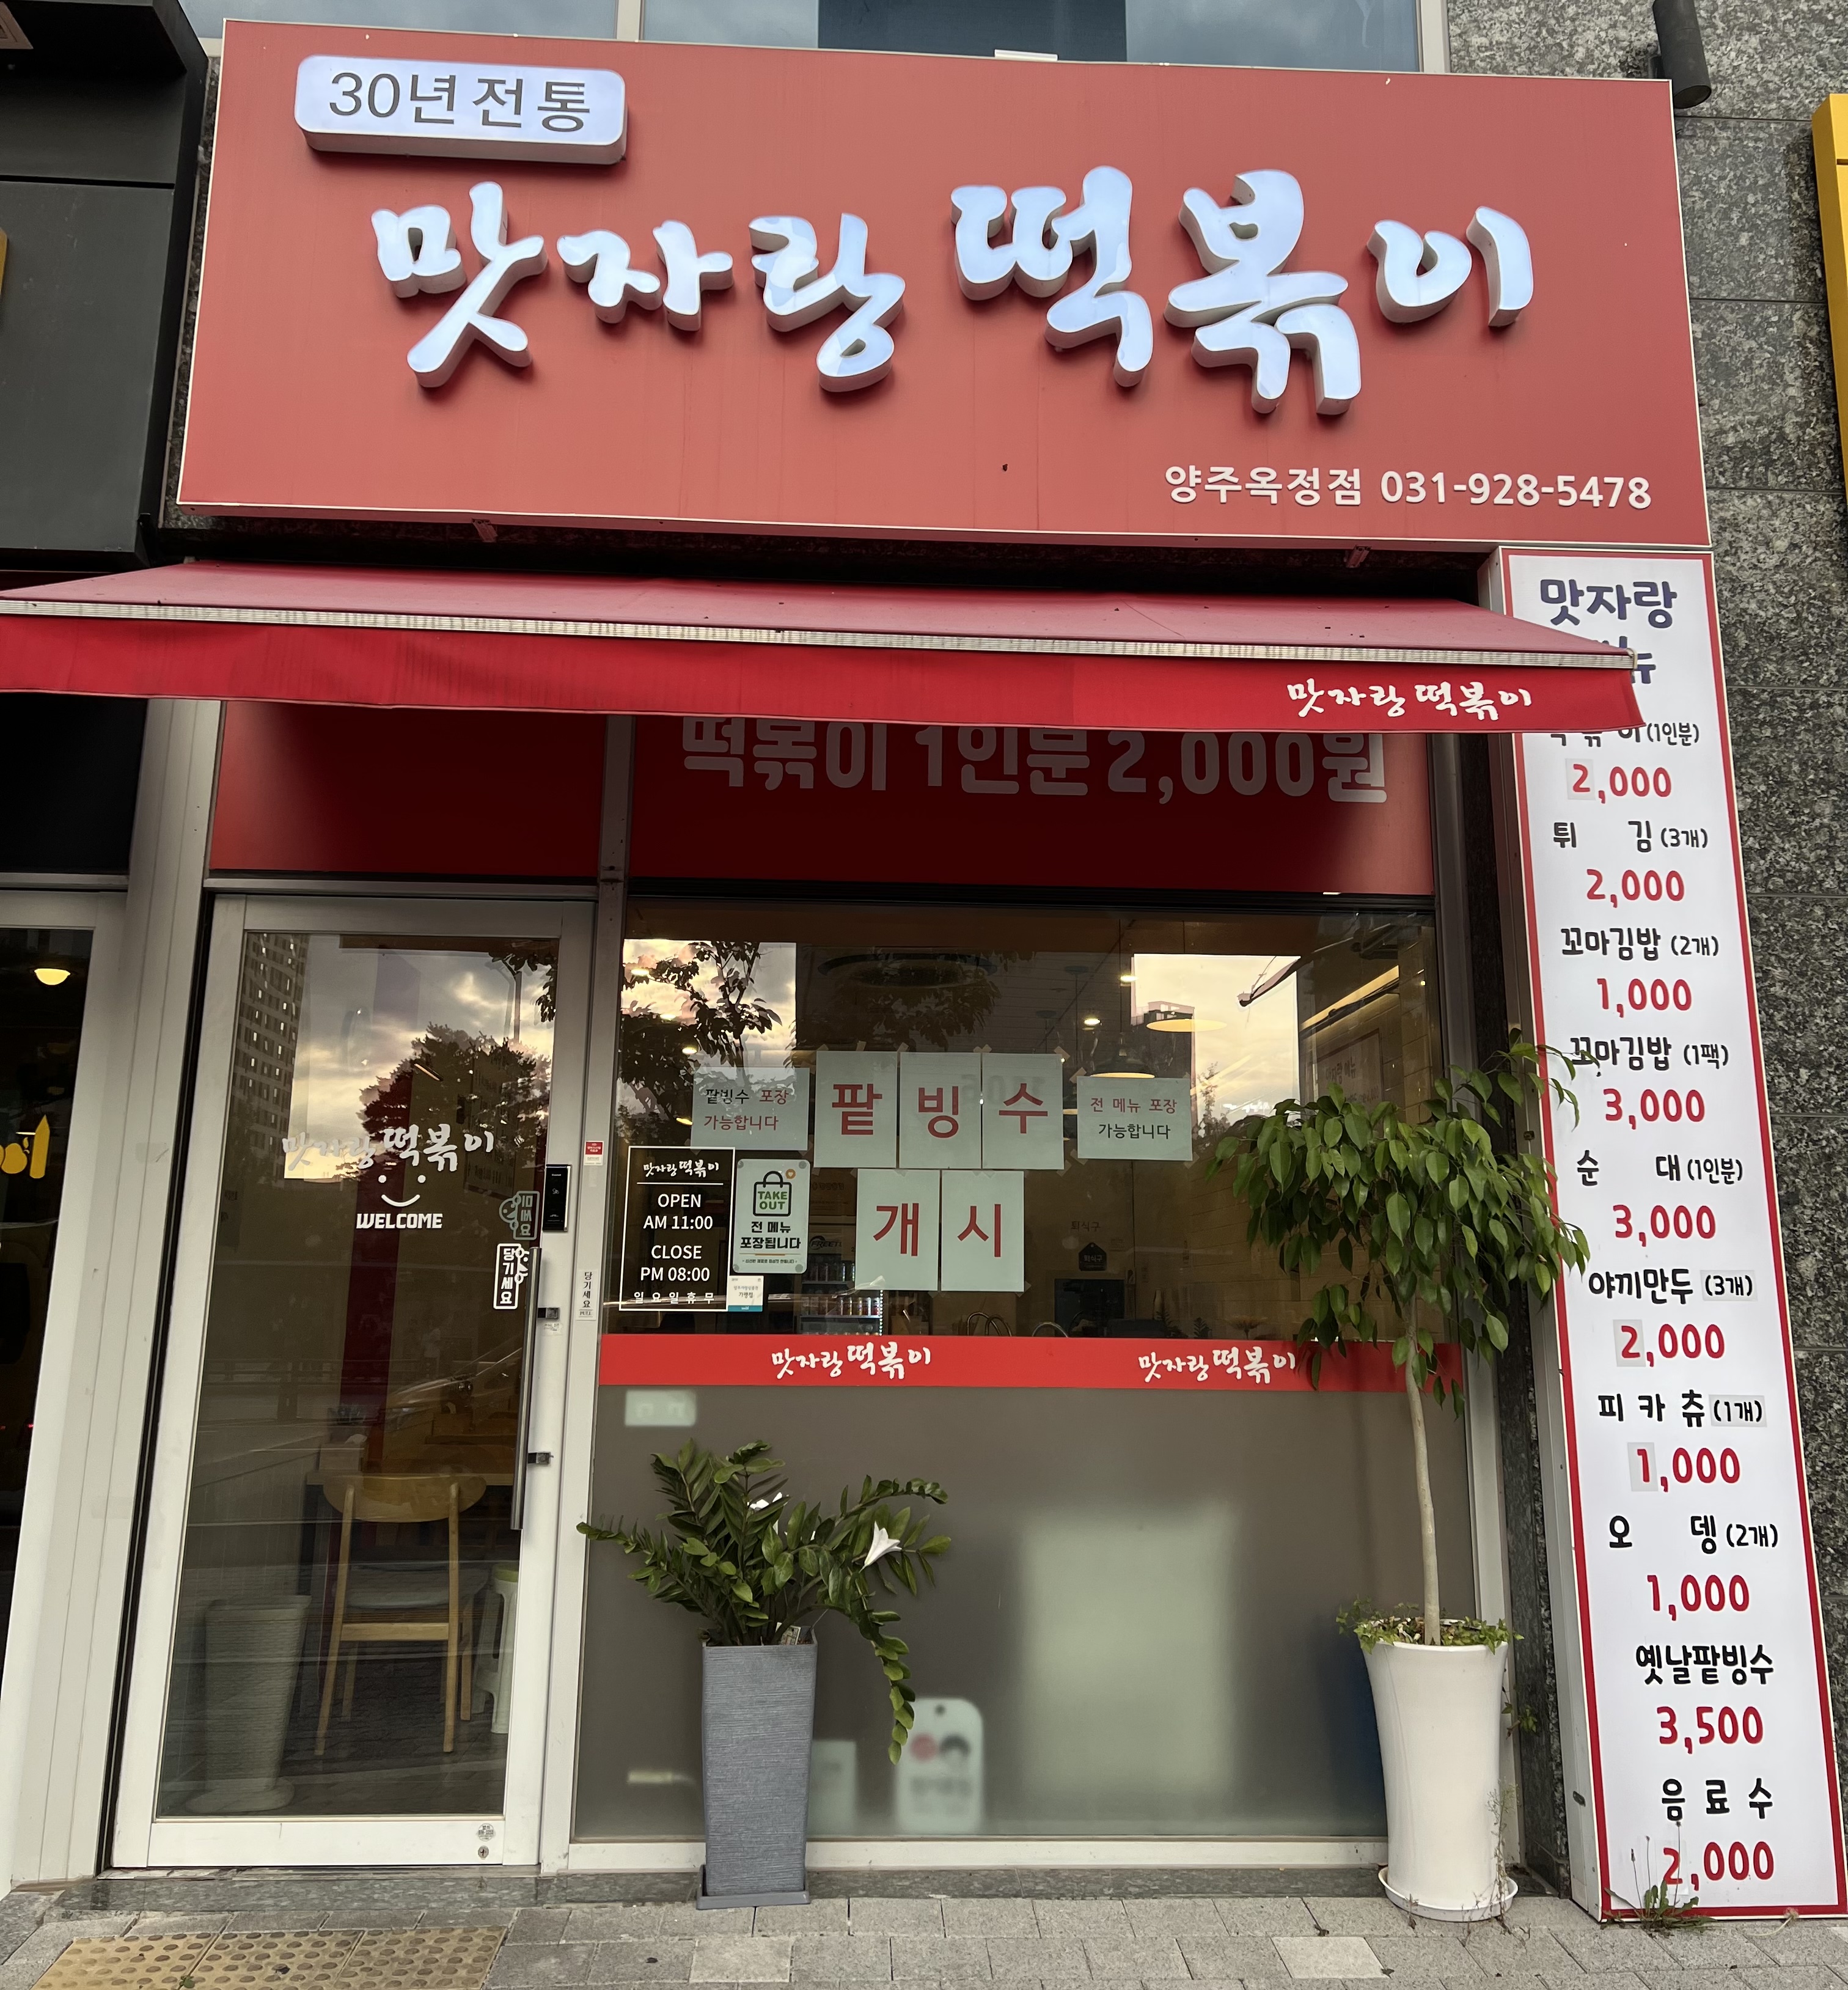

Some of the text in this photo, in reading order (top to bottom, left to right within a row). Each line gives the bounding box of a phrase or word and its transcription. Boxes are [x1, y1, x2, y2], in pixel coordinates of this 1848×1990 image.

[370, 165, 1535, 415] 맛자랑 떡볶이
[1164, 465, 1652, 510] 양주옥정점 031-928-5478
[1540, 579, 1678, 629] 맛자랑
[1286, 678, 1532, 721] 맛자랑 떡볶이
[682, 716, 1388, 805] 떡볶이 1인분 2,000원
[1572, 763, 1672, 804] 2,000
[1660, 828, 1709, 849] (3개)
[1586, 868, 1685, 909] 2,000
[1560, 927, 1719, 961] 꼬마김밥 (2개)
[1596, 978, 1692, 1018] 1,000
[1570, 1036, 1729, 1071] 꼬마김밥 (1팩)
[705, 1089, 790, 1106] 팥빙수 포장
[1090, 1097, 1178, 1114] 전 메뉴 포장
[1603, 1088, 1706, 1130] 3,000
[704, 1115, 779, 1131] 가능합니다
[1098, 1123, 1172, 1140] 가능합니다
[282, 1123, 494, 1172] 맛자랑 떡볶이
[678, 1159, 719, 1178] 떡볶이
[1687, 1158, 1744, 1185] (1인분)
[658, 1193, 702, 1208] OPEN
[757, 1191, 788, 1201] TAKE
[759, 1201, 787, 1211] OUT
[356, 1213, 444, 1229] WELCOME
[643, 1215, 714, 1230] AM 11:00
[751, 1221, 791, 1234] 전 메뉴
[1612, 1204, 1717, 1247] 3,000
[651, 1244, 703, 1260] CLOSE
[740, 1236, 801, 1250] 포장됩니다
[500, 1247, 516, 1305] 당기세요
[582, 1271, 593, 1308] 당기세요
[640, 1266, 711, 1282] PM 08:00
[1588, 1268, 1753, 1305] 야끼만두 (3개)
[771, 1341, 931, 1379] 맛자랑 떡볶이
[1621, 1323, 1726, 1368] 2,000
[1138, 1346, 1296, 1384] 맛자랑 떡볶이
[1713, 1399, 1763, 1423] (1개)
[1636, 1447, 1741, 1493] 1,000
[1725, 1523, 1780, 1548] (2개)
[1646, 1574, 1750, 1621] 1,000
[1635, 1644, 1775, 1686] 옛날팥빙수
[1656, 1705, 1764, 1755] 3,500
[1663, 1841, 1775, 1892] 2,000
